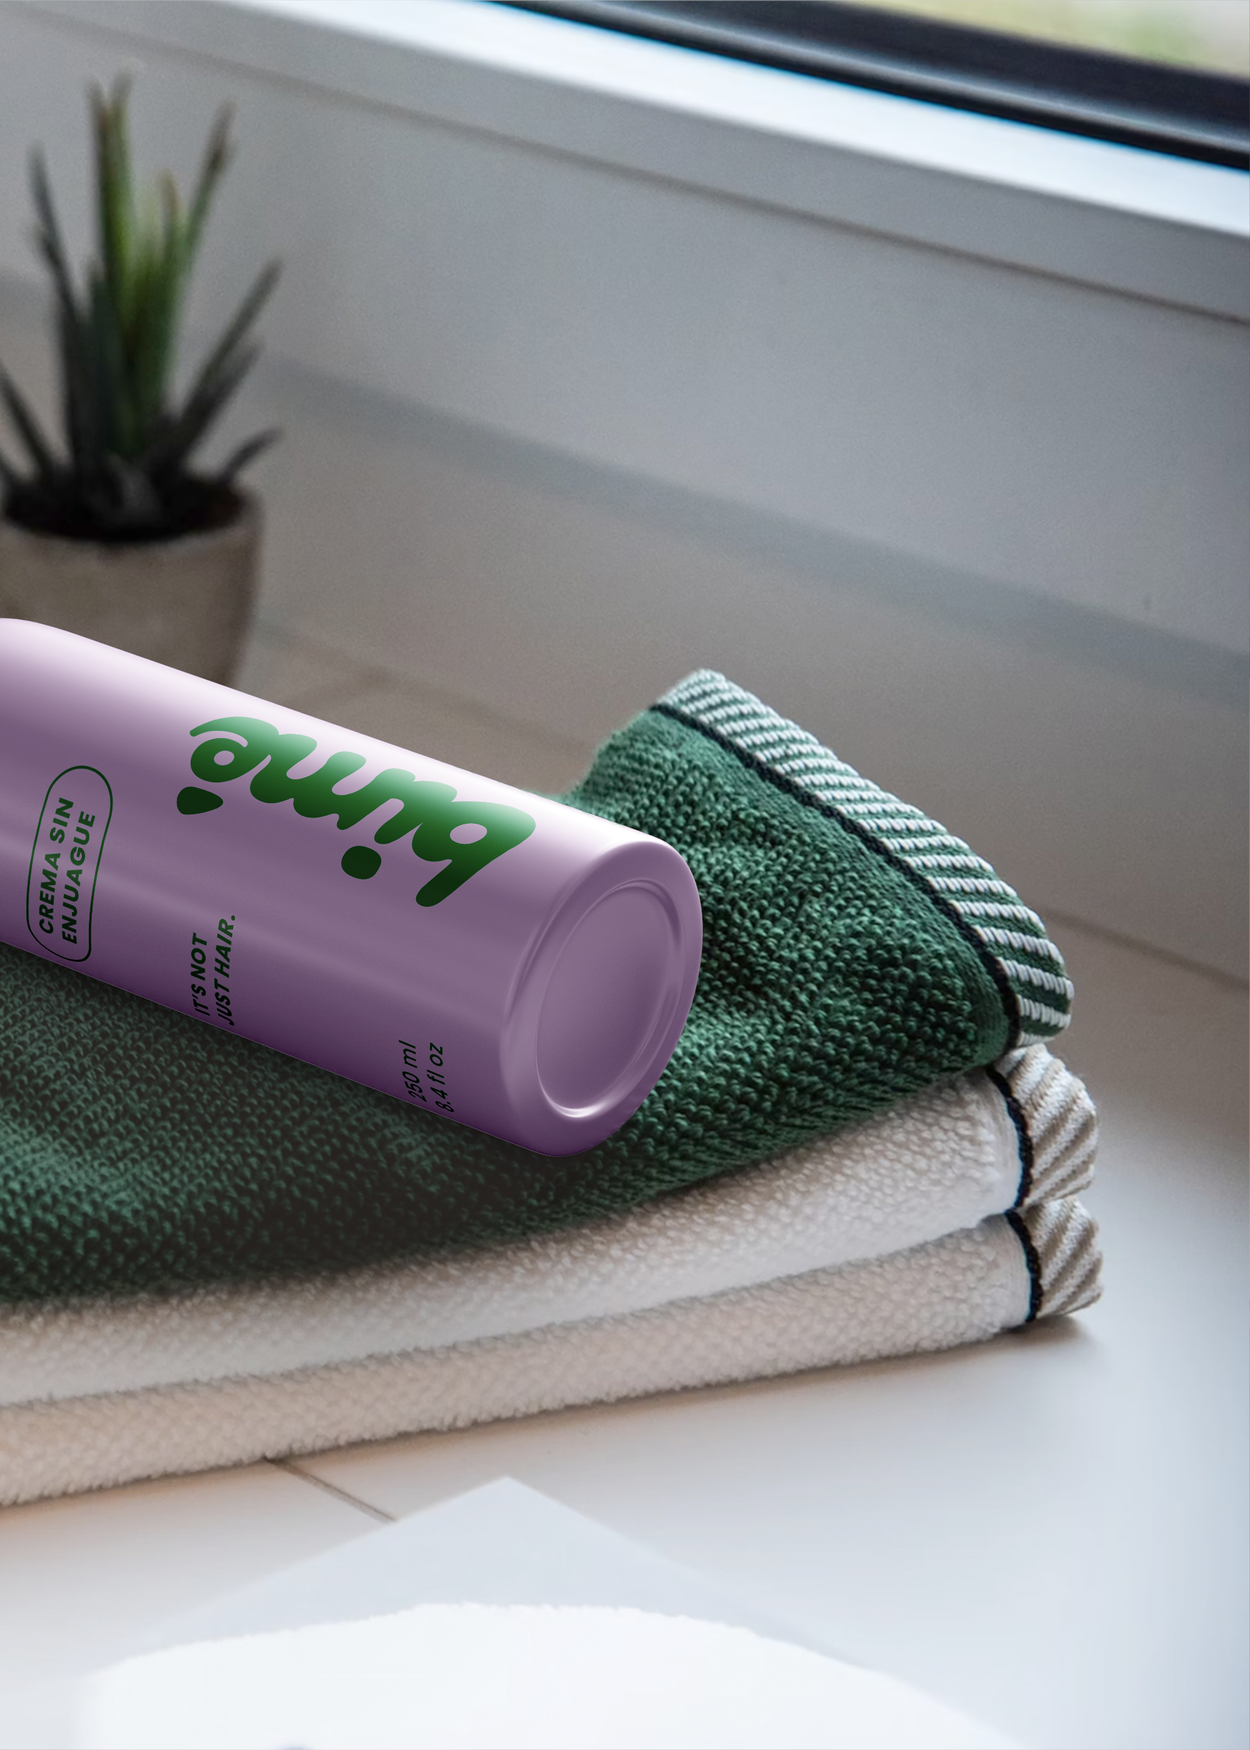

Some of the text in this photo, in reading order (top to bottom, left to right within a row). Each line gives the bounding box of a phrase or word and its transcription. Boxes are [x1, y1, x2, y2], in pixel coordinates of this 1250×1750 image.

[39, 797, 74, 934] CREMA SIN
[177, 716, 536, 907] bimé
[61, 811, 96, 944] ENJUAGUE
[190, 932, 210, 1016] IT'S NOT
[214, 915, 236, 1026] JUST HAIR.
[399, 1039, 427, 1102] 250 ml
[426, 1042, 455, 1113] 8.4 fl oz
